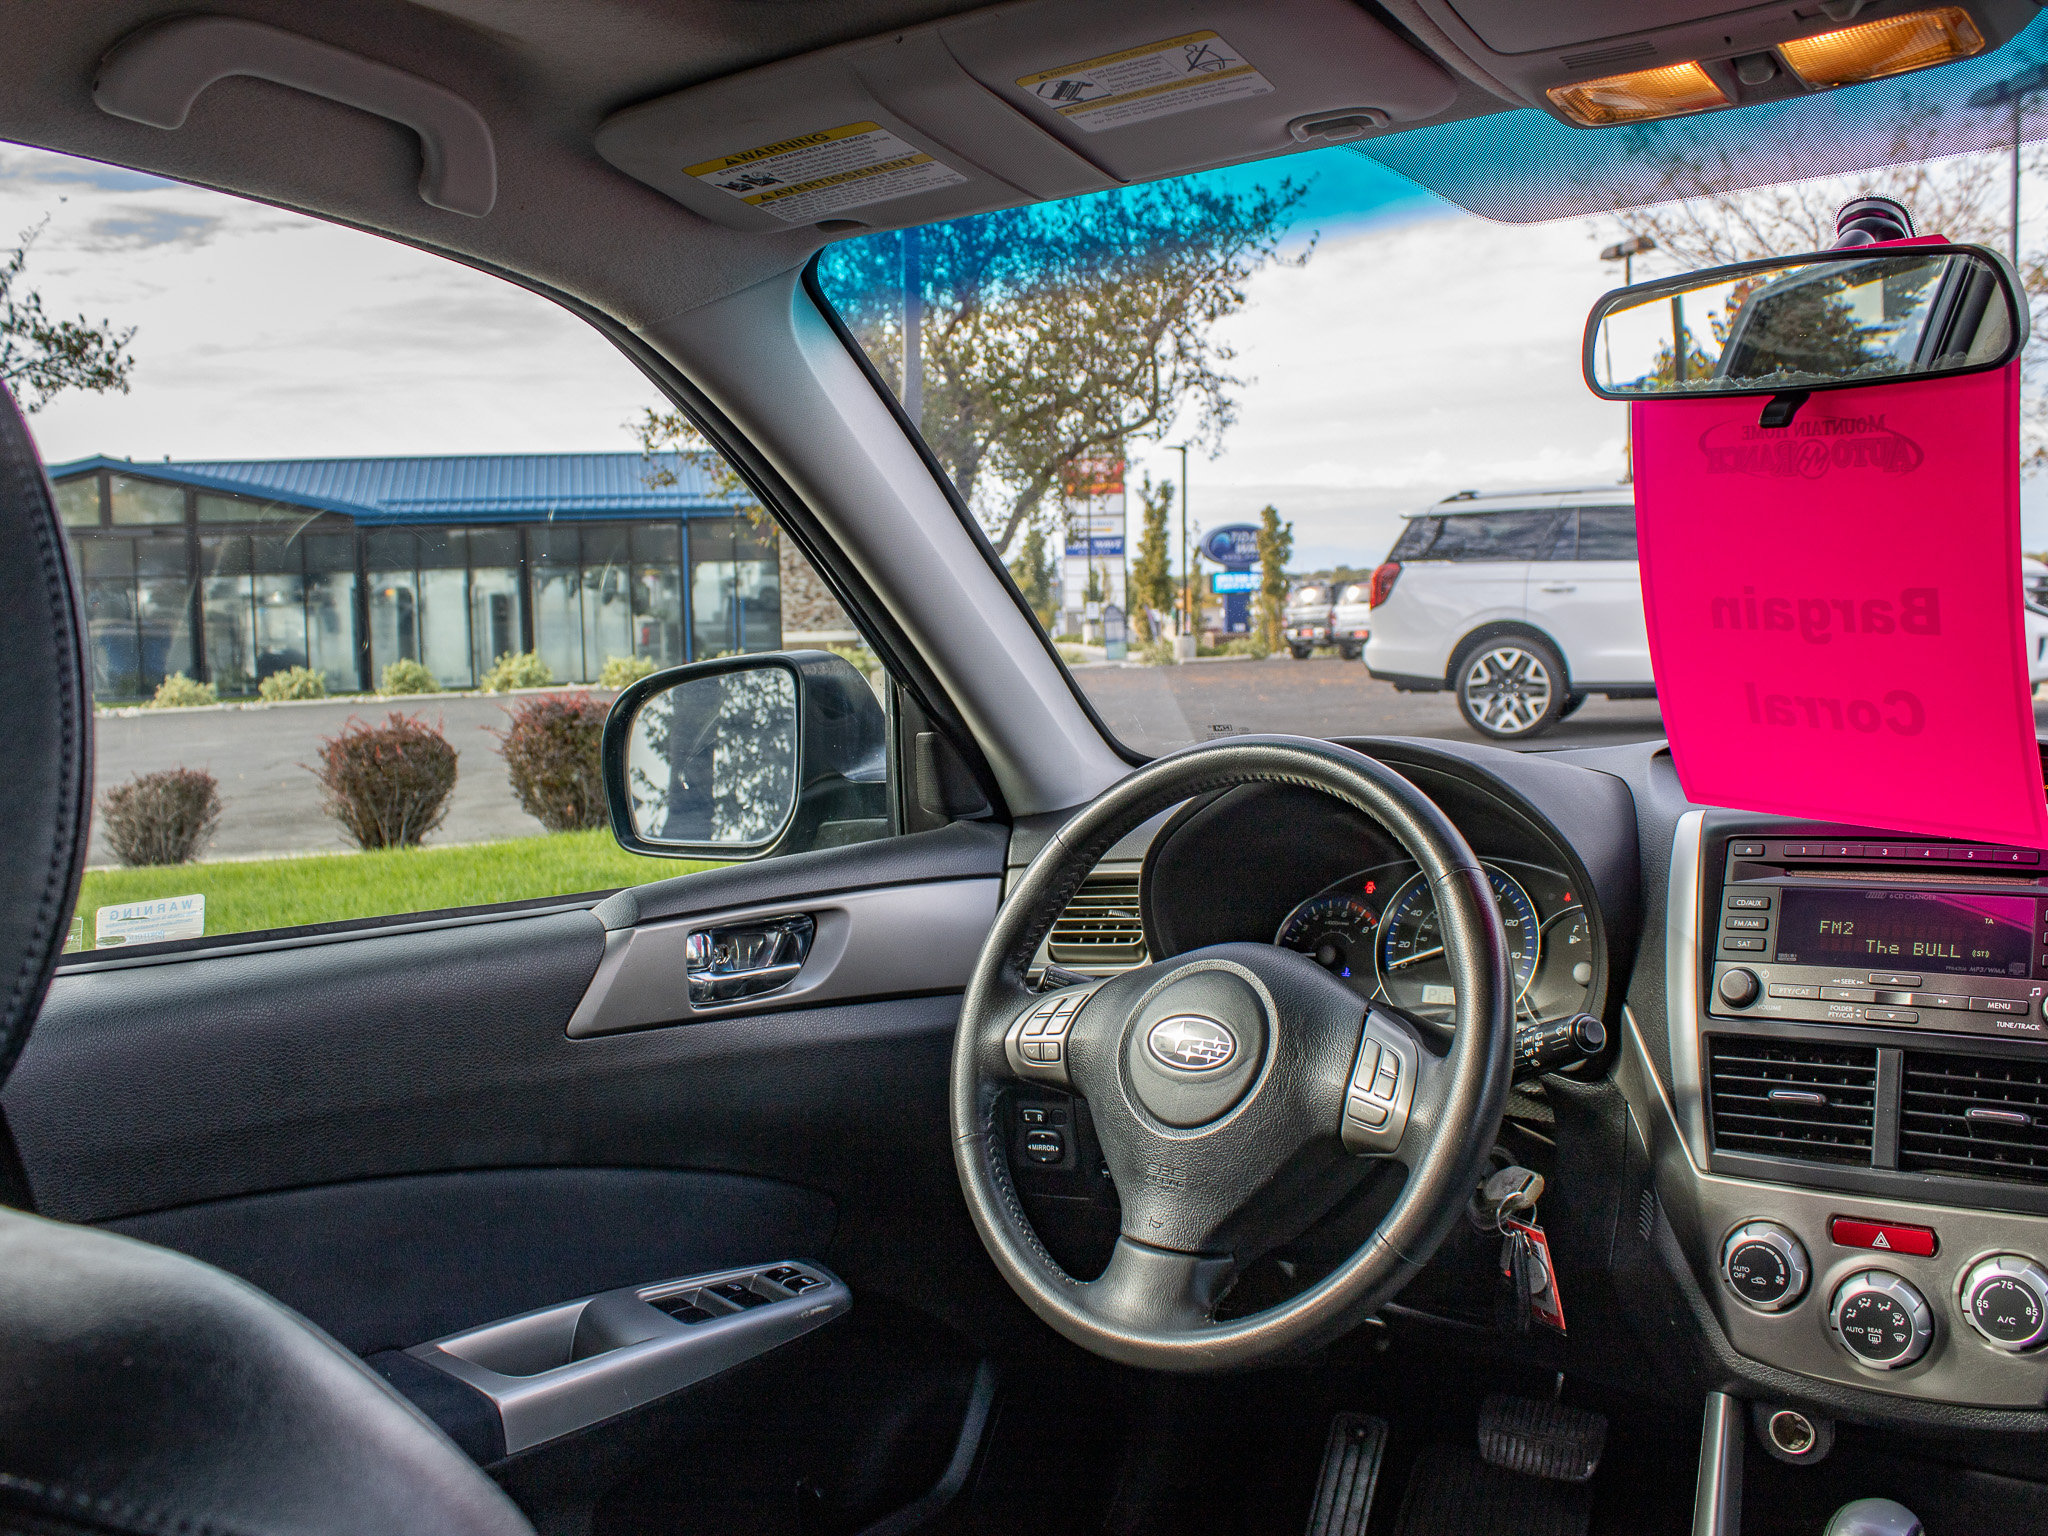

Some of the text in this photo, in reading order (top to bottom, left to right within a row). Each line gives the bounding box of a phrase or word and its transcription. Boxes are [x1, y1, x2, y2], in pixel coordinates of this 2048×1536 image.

[733, 132, 832, 161] WARNING
[773, 157, 917, 197] AVERTISSEMENT
[1410, 909, 1423, 917] 40
[1504, 919, 1519, 927] 120
[1984, 917, 1994, 925] TA
[1361, 926, 1369, 934] 8
[1572, 925, 1580, 933] F
[1819, 920, 1855, 935] FM2
[1865, 939, 1961, 958] The BULL
[1778, 988, 1810, 996] PTY/CAT
[1987, 1002, 2011, 1010] MENU
[1828, 1011, 1854, 1019] PTY/CAT
[1996, 1020, 2041, 1031] TUNE/TRACK
[1024, 1114, 1030, 1122] L
[1037, 1114, 1043, 1122] R
[1031, 1144, 1055, 1152] MIRROR
[1147, 1163, 1186, 1177] SRS
[1145, 1175, 1185, 1189] AIRBAG
[1732, 1265, 1750, 1273] AUTO
[1733, 1272, 1747, 1280] OFF
[2000, 1280, 2014, 1290] 75
[1976, 1298, 1989, 1309] 65
[2025, 1306, 2039, 1317] 85
[1996, 1315, 2016, 1326] A/C
[1845, 1325, 1864, 1334] AUTO
[1866, 1326, 1883, 1335] REAR
